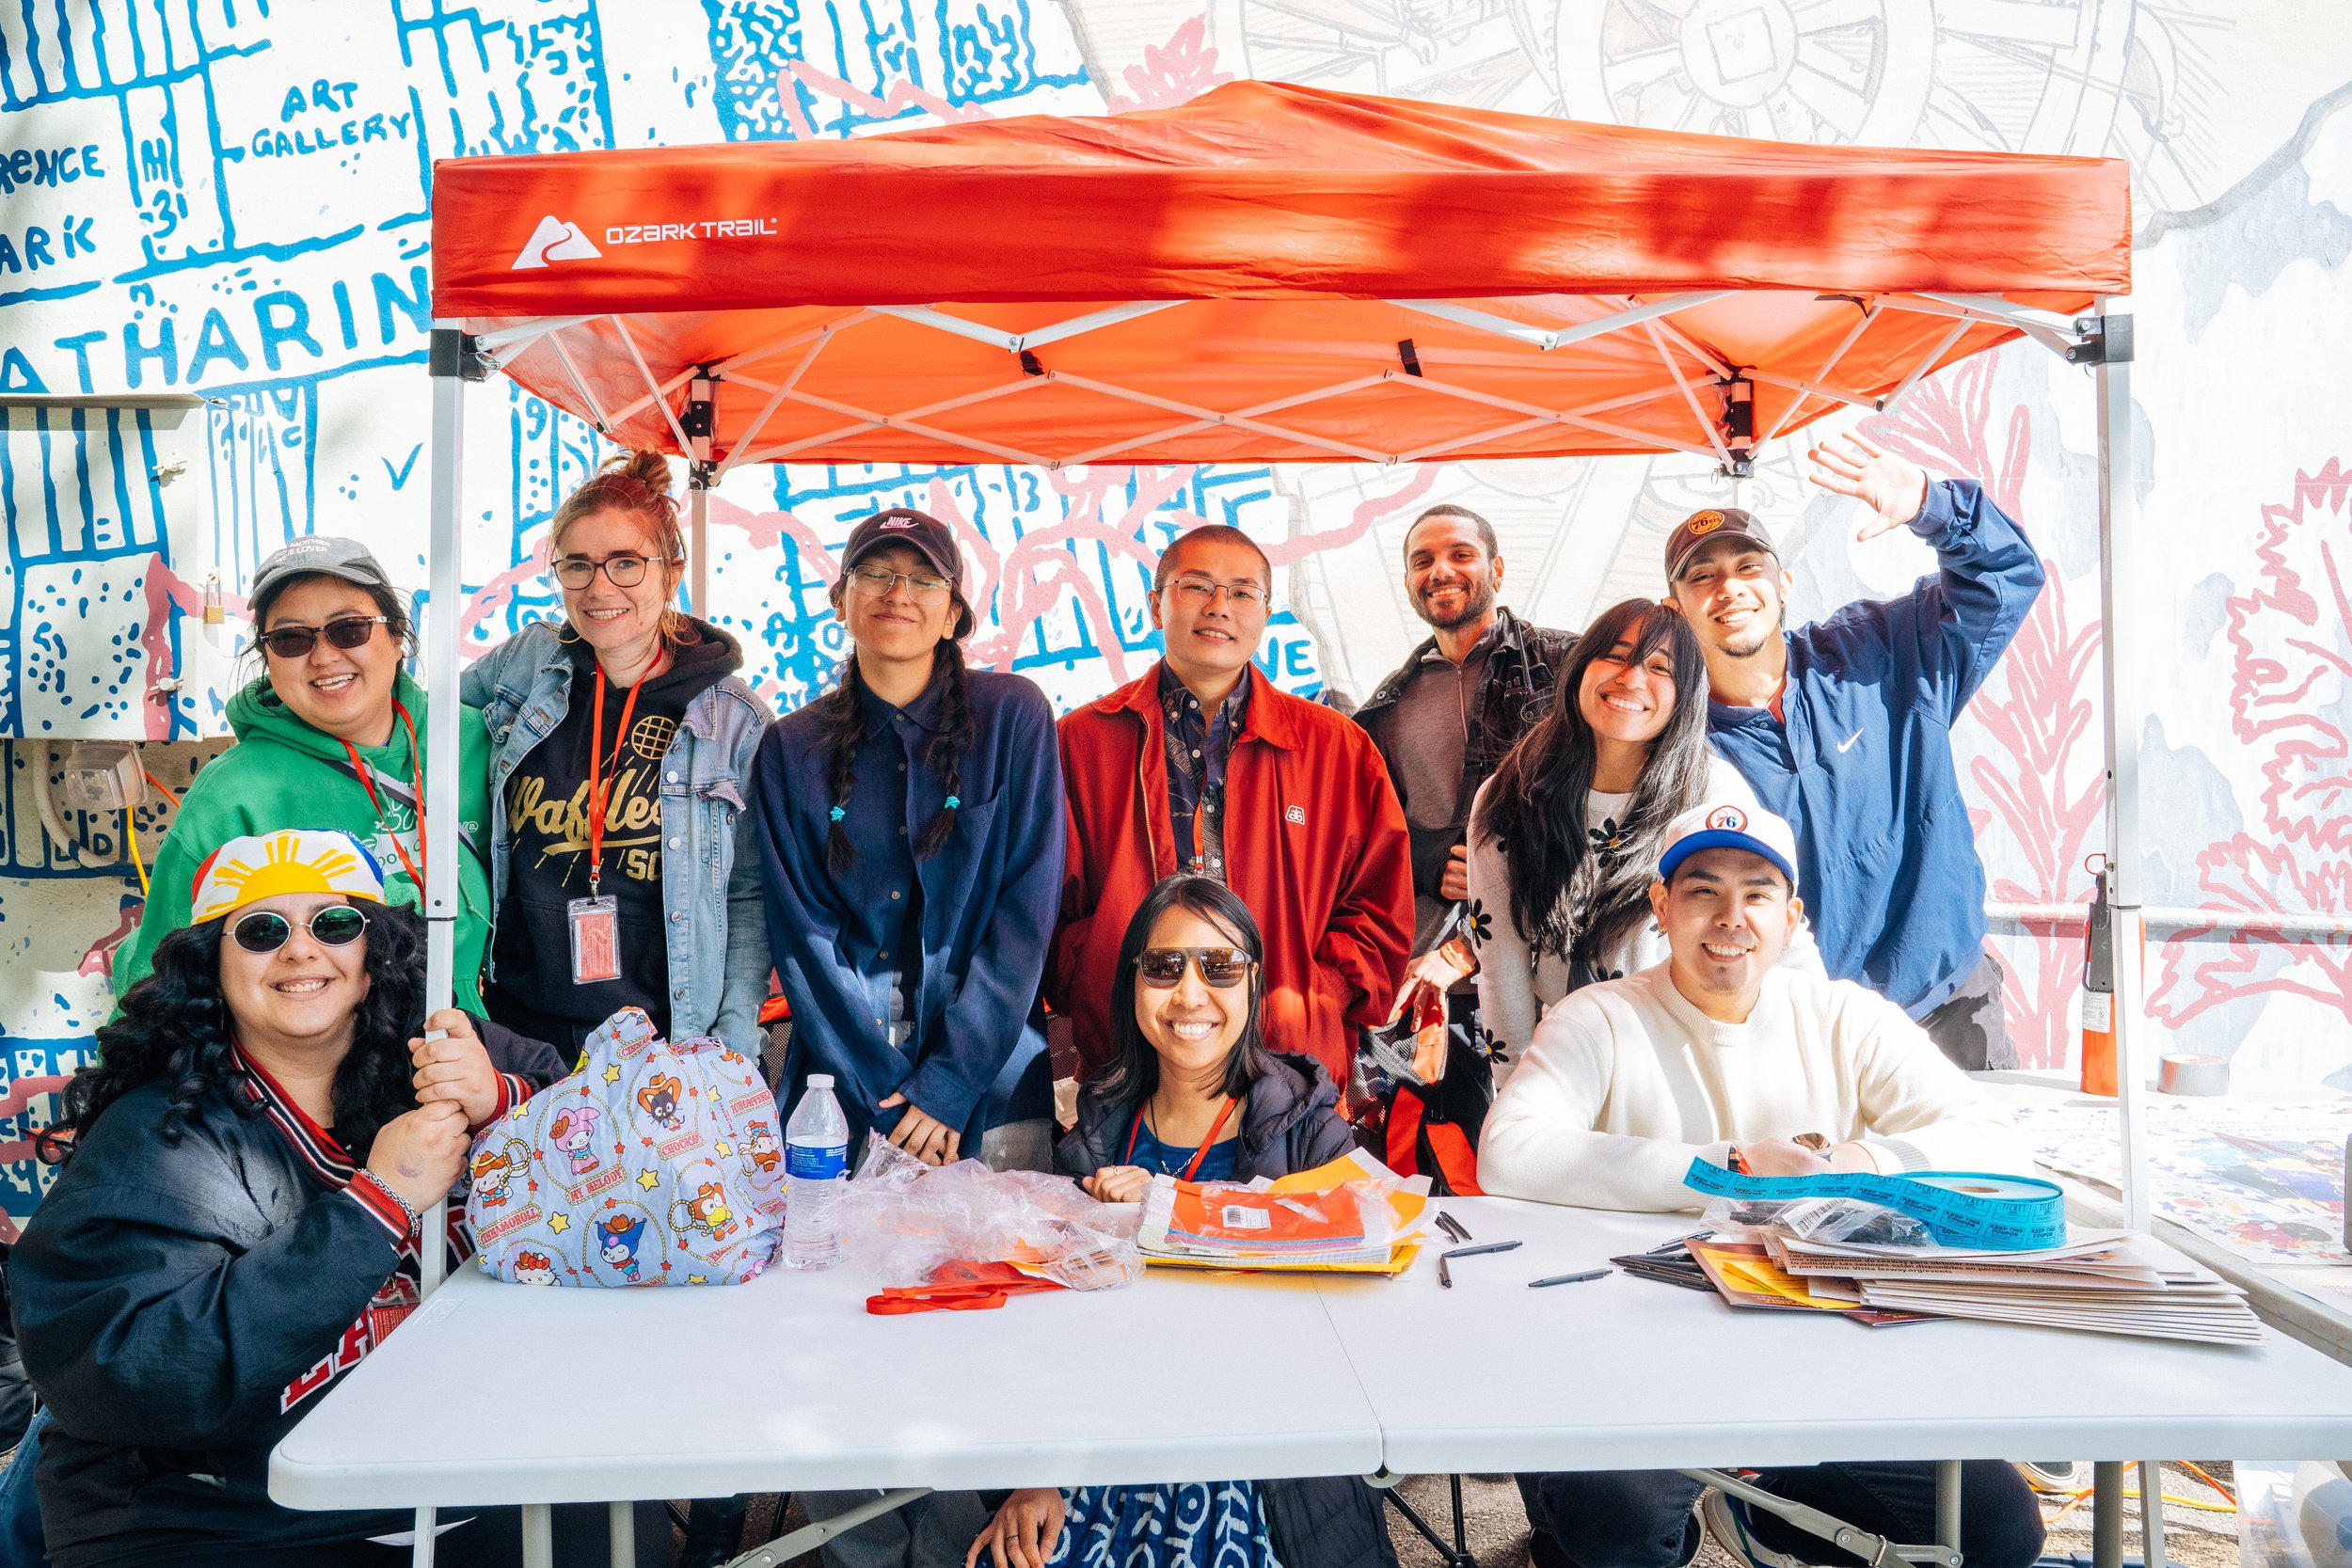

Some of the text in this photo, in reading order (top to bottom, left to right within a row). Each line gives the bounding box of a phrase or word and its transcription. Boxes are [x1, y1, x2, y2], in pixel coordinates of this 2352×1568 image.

[282, 79, 358, 121] ART
[252, 113, 410, 158] GALLERY
[606, 222, 696, 245] OZARK
[886, 516, 912, 527] NIKE
[291, 538, 330, 546] MOTHER
[296, 545, 327, 553] LOVER
[1716, 816, 1737, 828] 76
[1871, 1174, 1898, 1183] TICKET
[570, 1168, 623, 1202] MY MELODY
[1915, 1183, 1941, 1194] TICKET
[1959, 1195, 1984, 1206] TICKET
[1905, 1201, 1931, 1212] COUPON
[1947, 1216, 1975, 1227] COUPON
